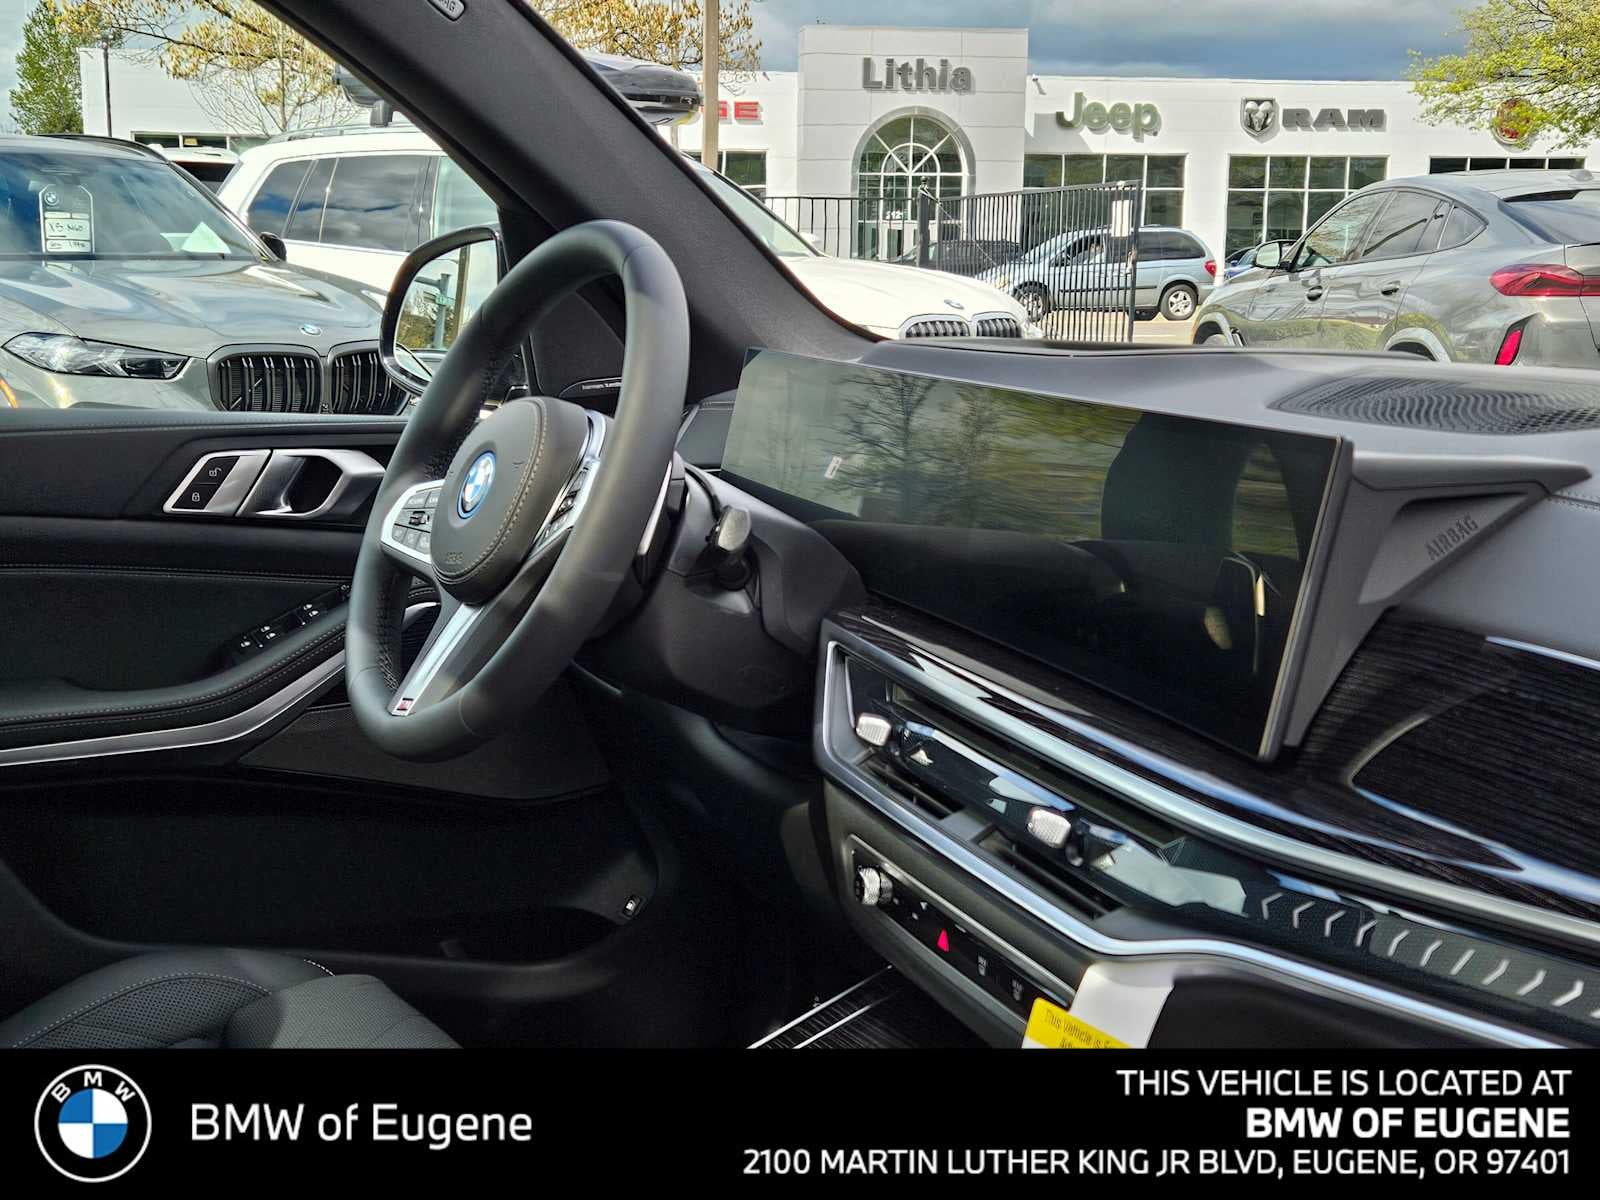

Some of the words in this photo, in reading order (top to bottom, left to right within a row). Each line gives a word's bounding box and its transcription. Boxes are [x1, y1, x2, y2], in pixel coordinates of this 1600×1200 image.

[862, 57, 973, 93] Lithia
[1055, 91, 1161, 141] Jeep
[1282, 107, 1386, 131] RAM
[1426, 515, 1479, 561] AIRBAG
